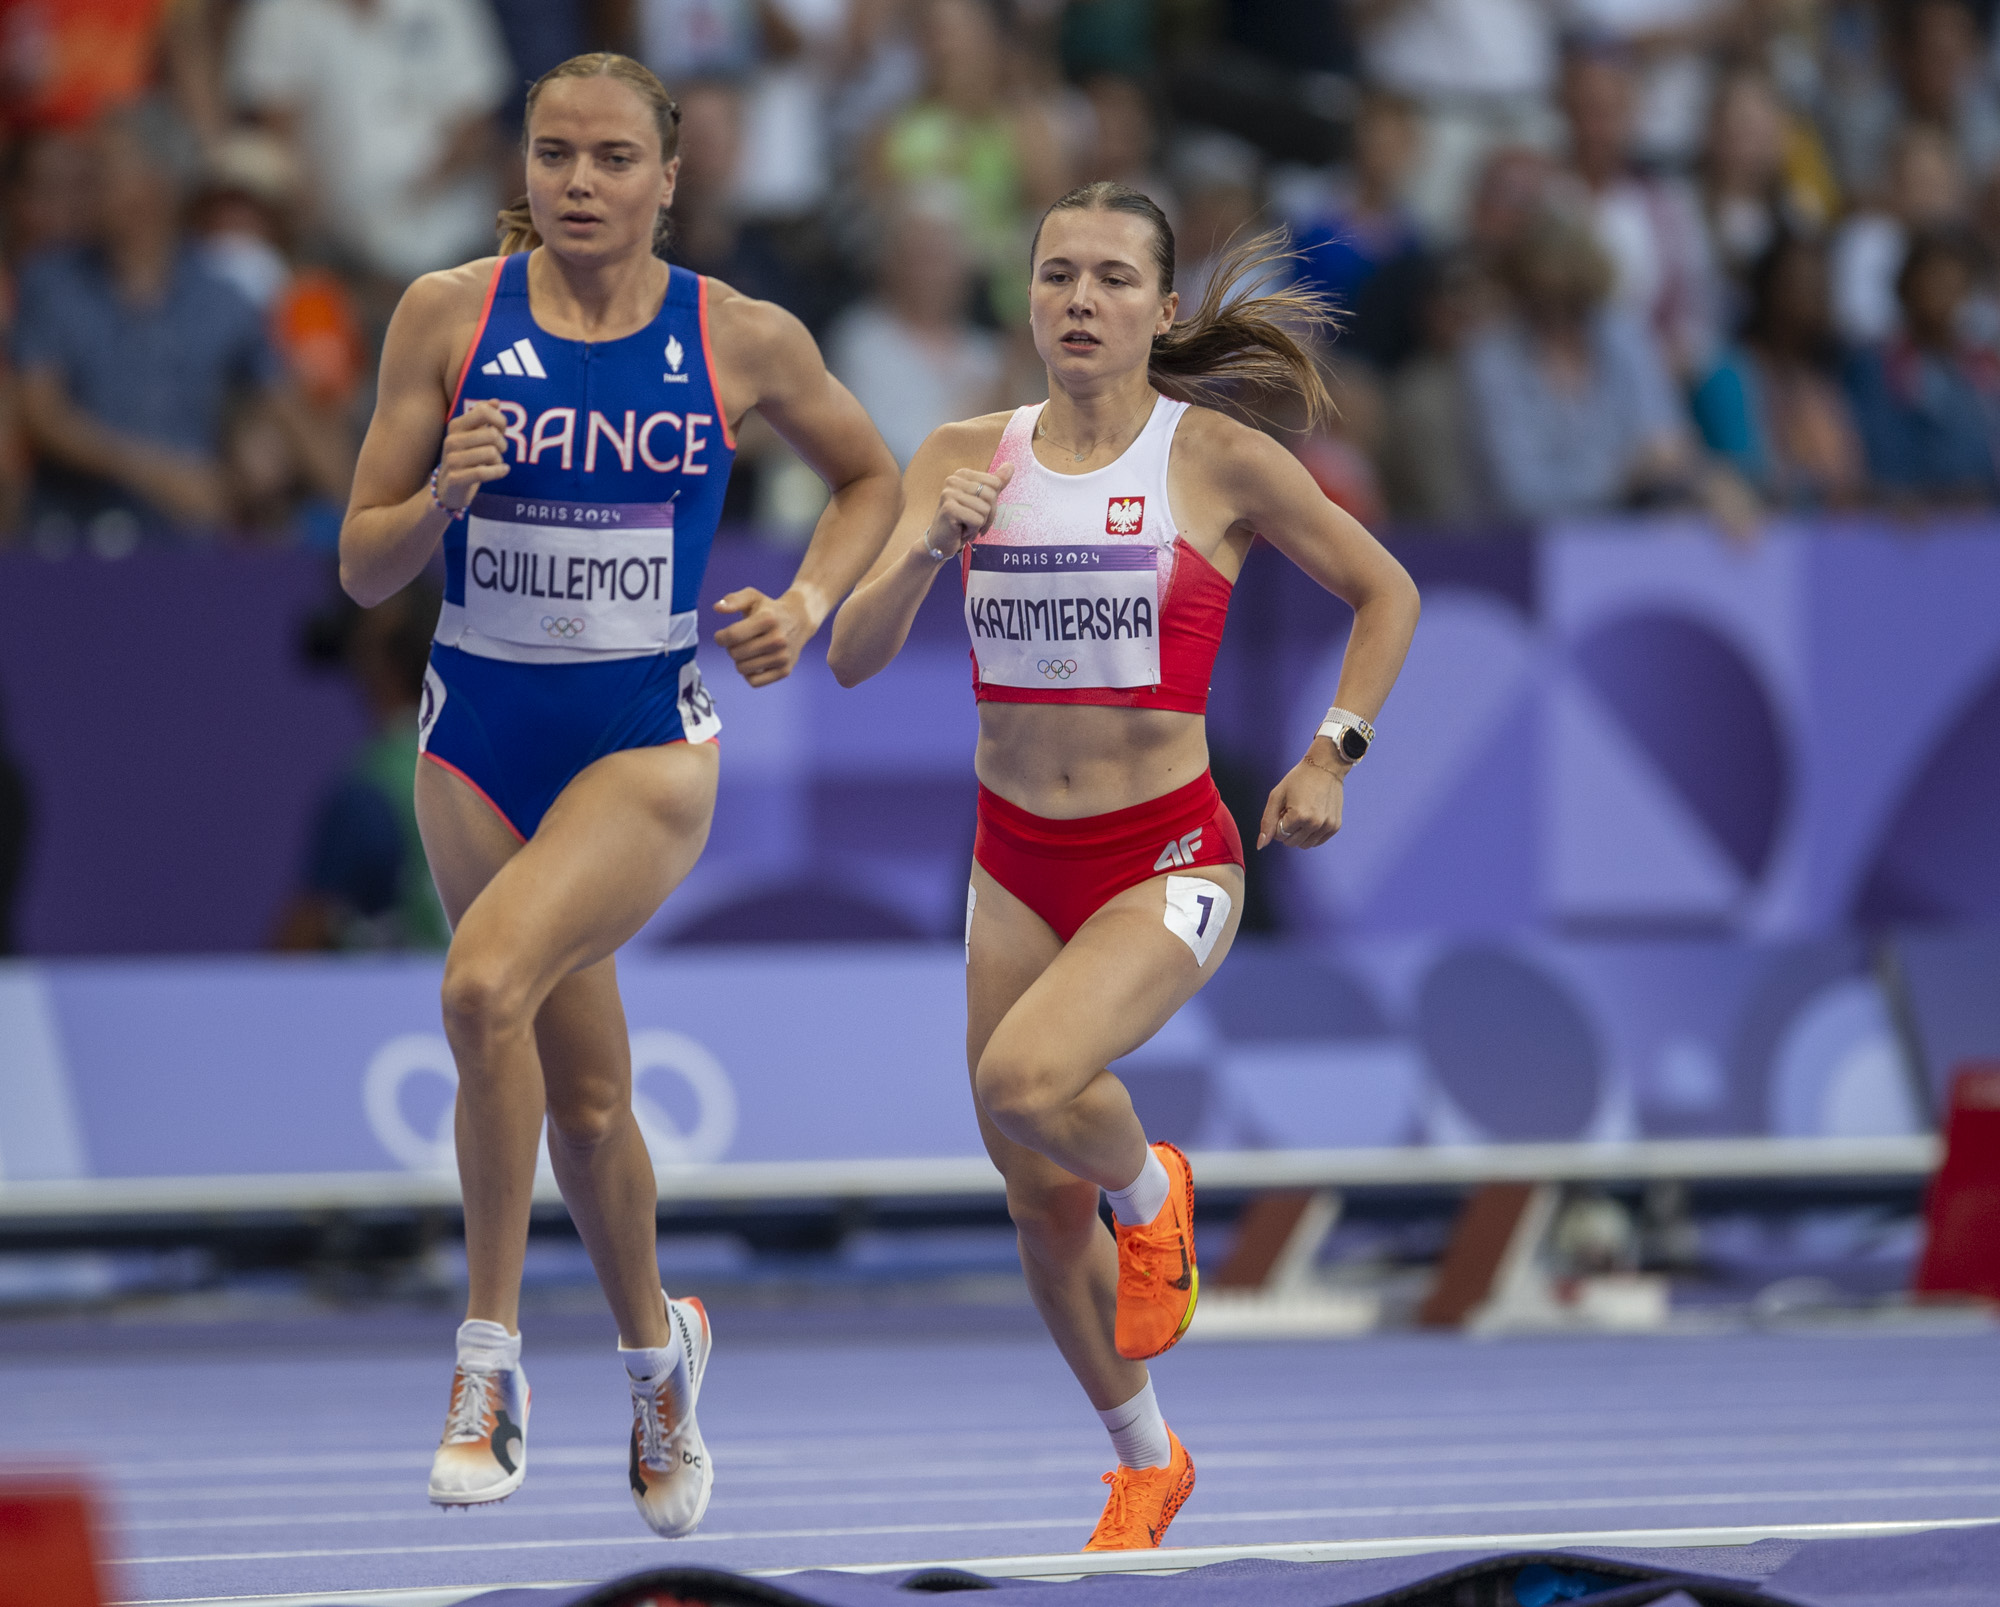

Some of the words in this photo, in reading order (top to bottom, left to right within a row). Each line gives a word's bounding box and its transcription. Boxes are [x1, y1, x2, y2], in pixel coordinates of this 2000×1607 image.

[574, 509, 621, 523] 2024
[472, 547, 667, 600] GUILLEMOT
[1055, 552, 1100, 564] 2024
[971, 597, 1152, 641] KAZIMIERSKA
[1197, 895, 1214, 938] 1
